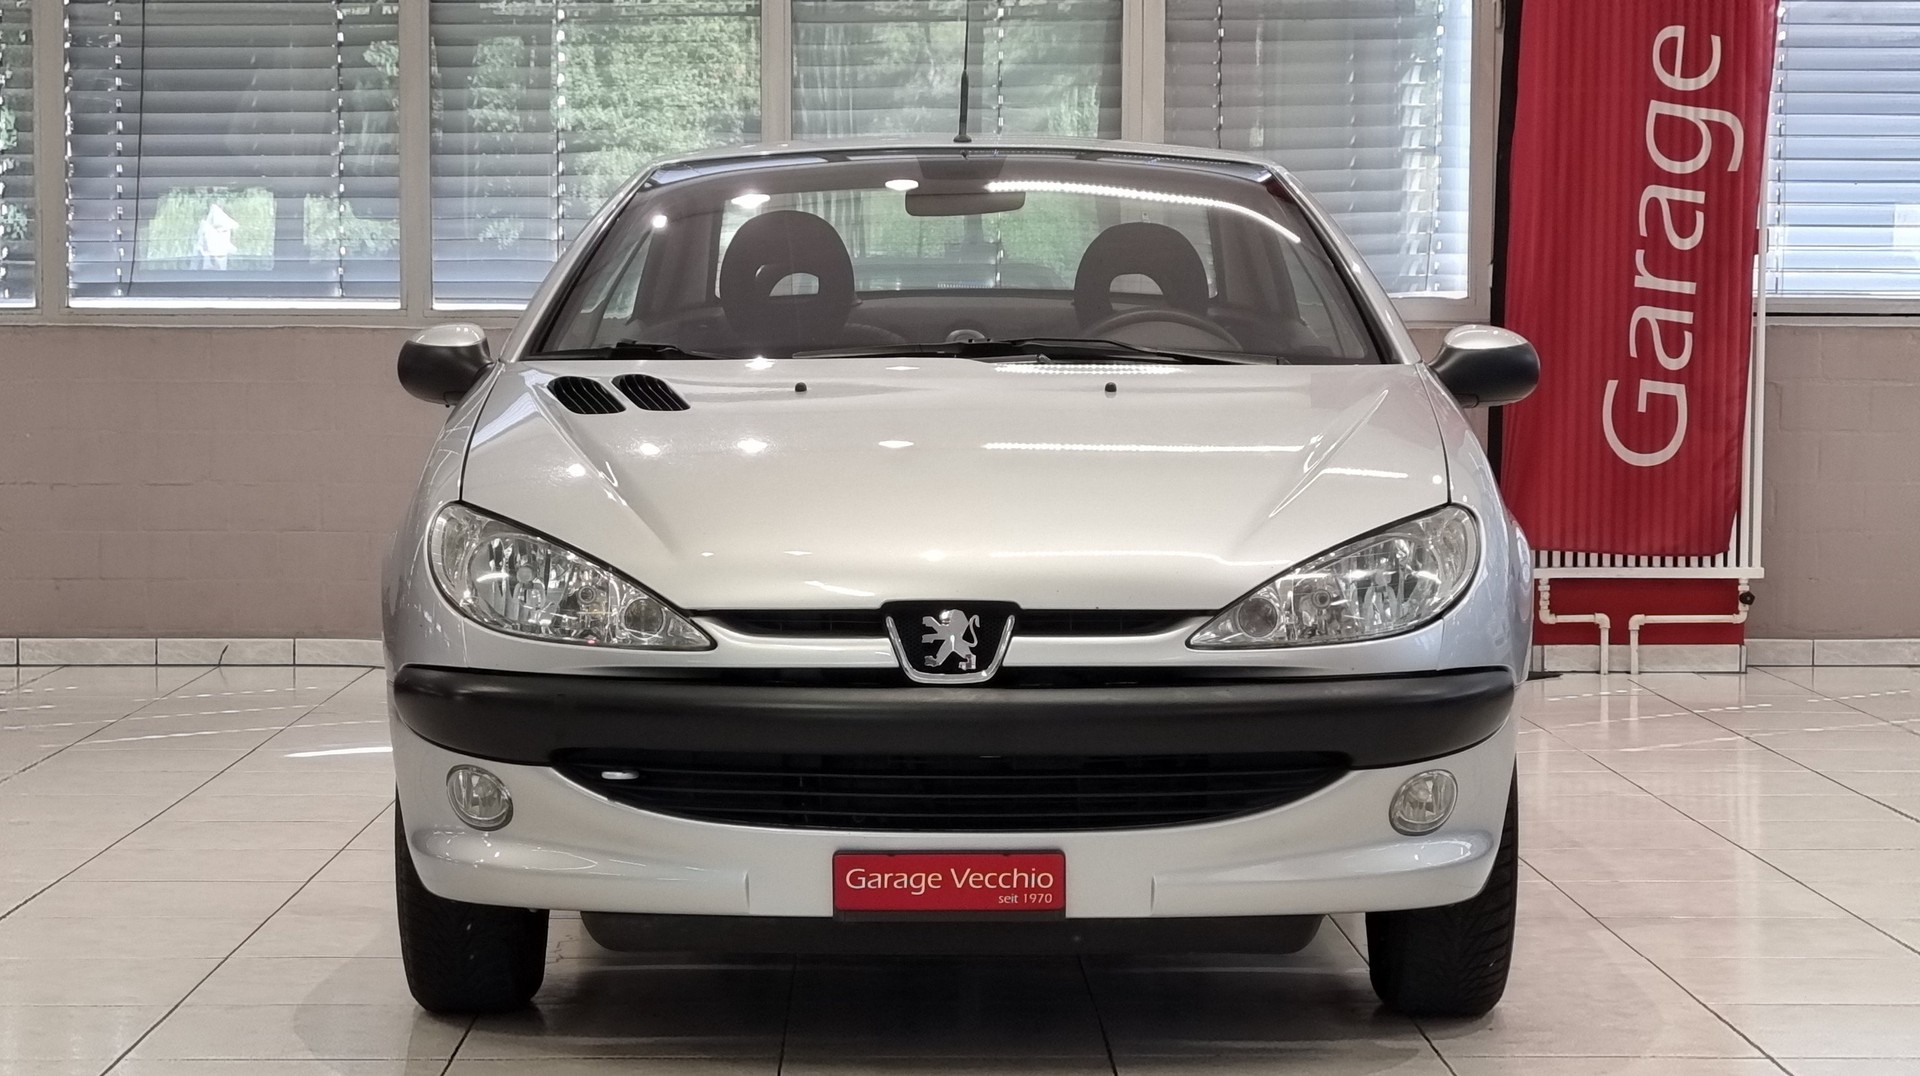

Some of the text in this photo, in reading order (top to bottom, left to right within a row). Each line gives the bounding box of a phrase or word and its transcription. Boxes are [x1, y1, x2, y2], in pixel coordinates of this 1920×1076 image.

[1602, 25, 1744, 467] Garage
[845, 868, 1054, 895] Garage Vecchio
[998, 893, 1053, 904] seit 1970
